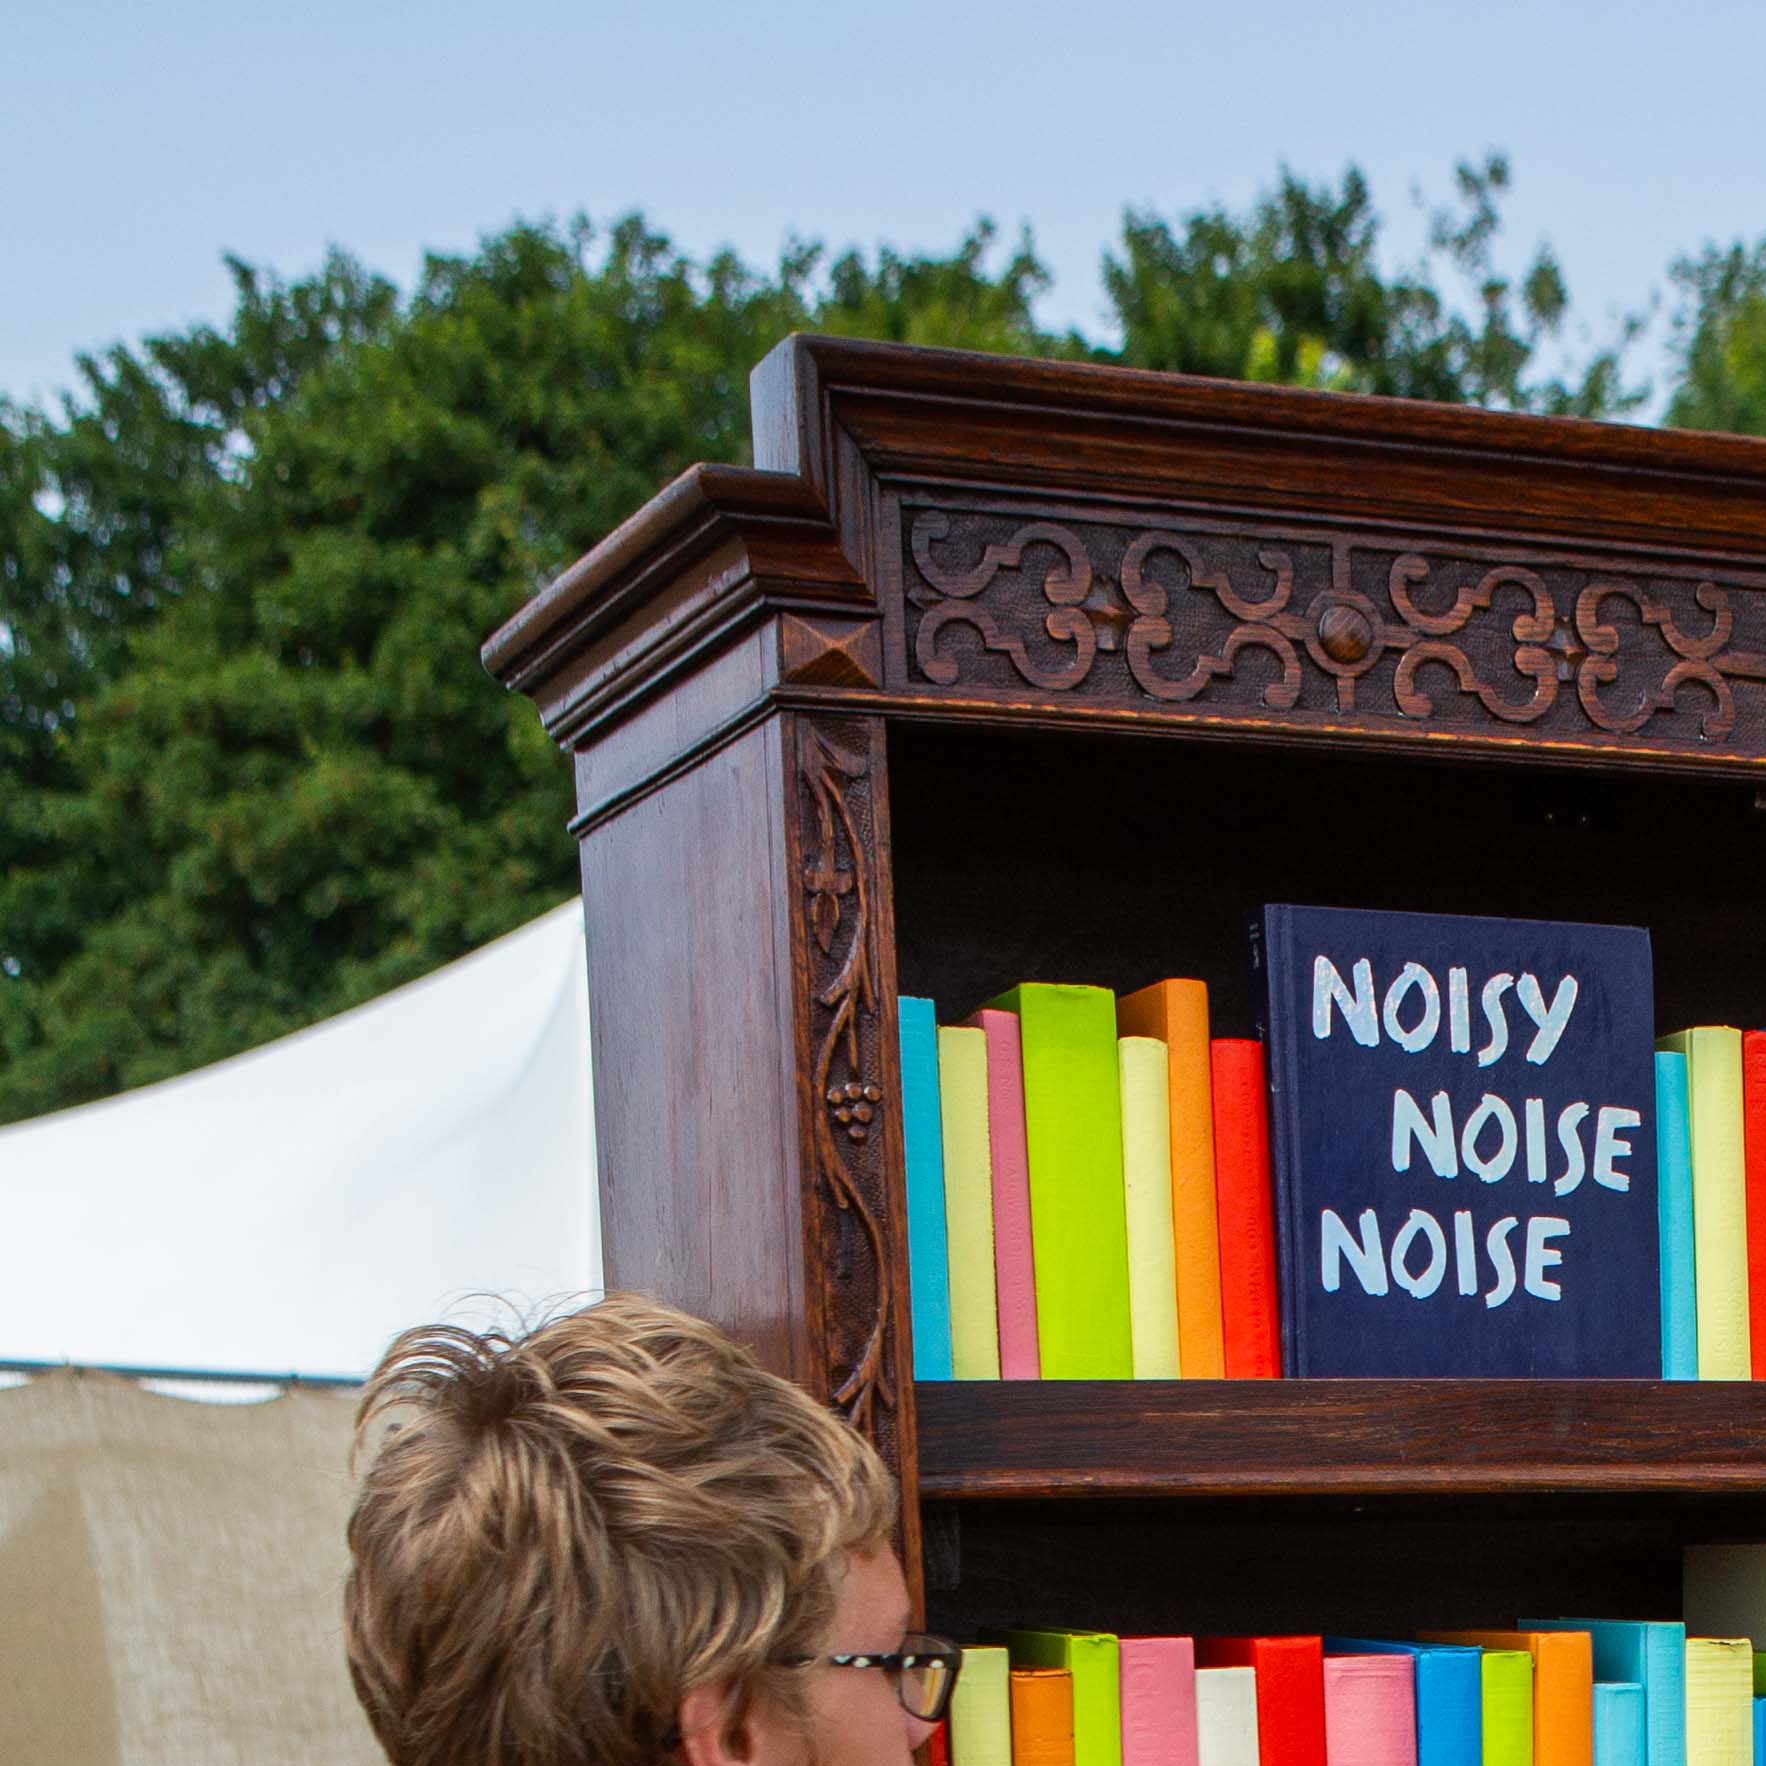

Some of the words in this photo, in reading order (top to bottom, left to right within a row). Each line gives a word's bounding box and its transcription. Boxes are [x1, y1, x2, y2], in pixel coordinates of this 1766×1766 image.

[1312, 954, 1579, 1068] NOISY
[1391, 1088, 1642, 1197] NOISE
[1321, 1208, 1571, 1309] NOISE
